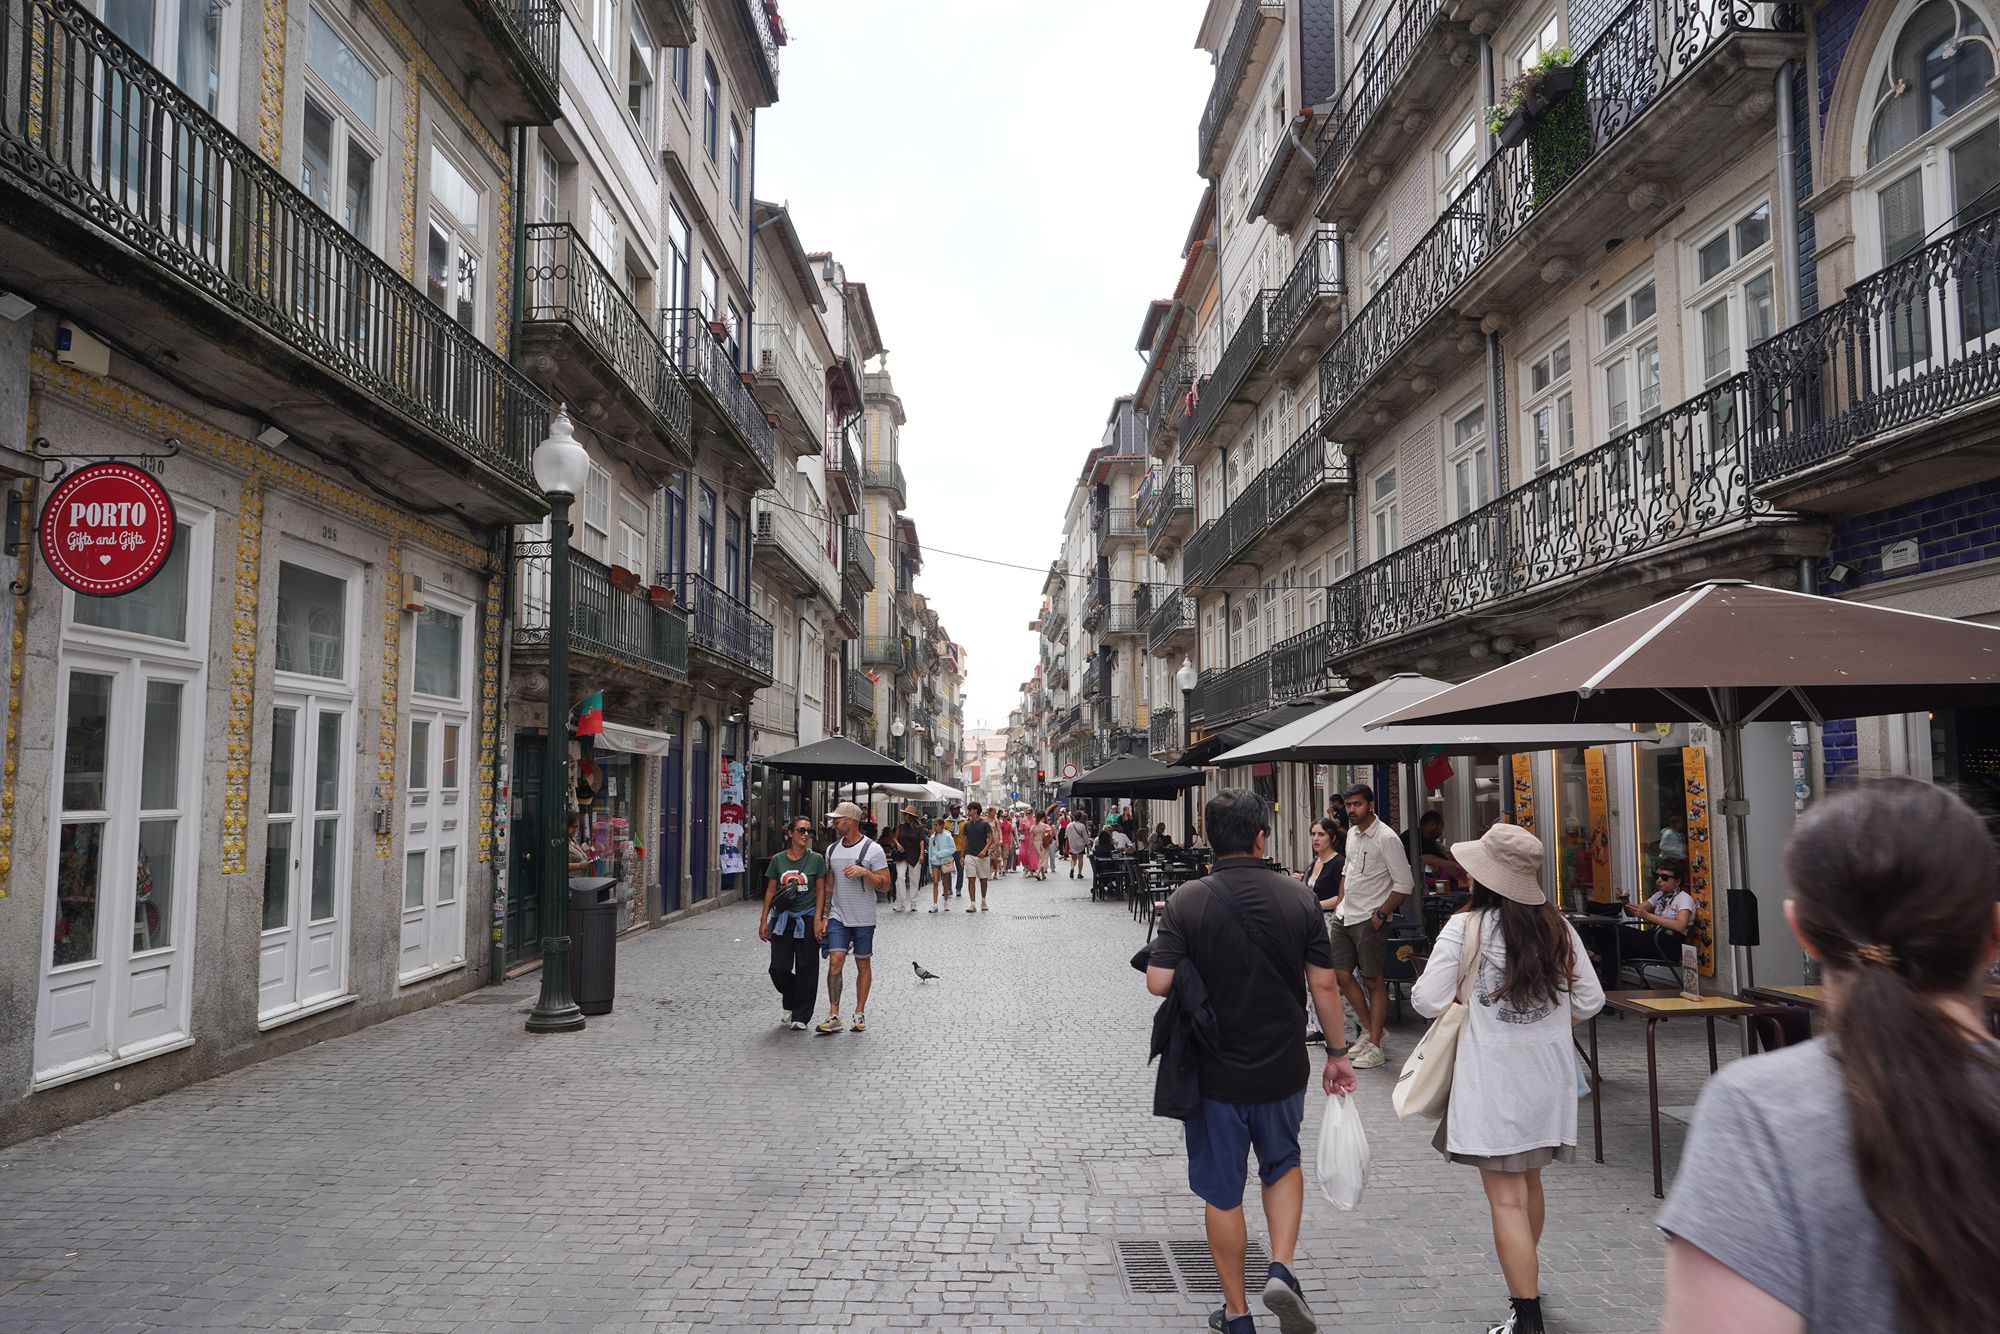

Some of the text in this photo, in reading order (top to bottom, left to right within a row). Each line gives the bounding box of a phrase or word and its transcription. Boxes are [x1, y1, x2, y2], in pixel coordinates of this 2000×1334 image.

[69, 502, 147, 527] PORTO
[322, 525, 338, 542] 328
[67, 531, 146, 551] Gifts and Gifts
[1588, 776, 1604, 785] WORLD
[1589, 785, 1604, 793] NEEDS
[1591, 793, 1603, 801] NATA
